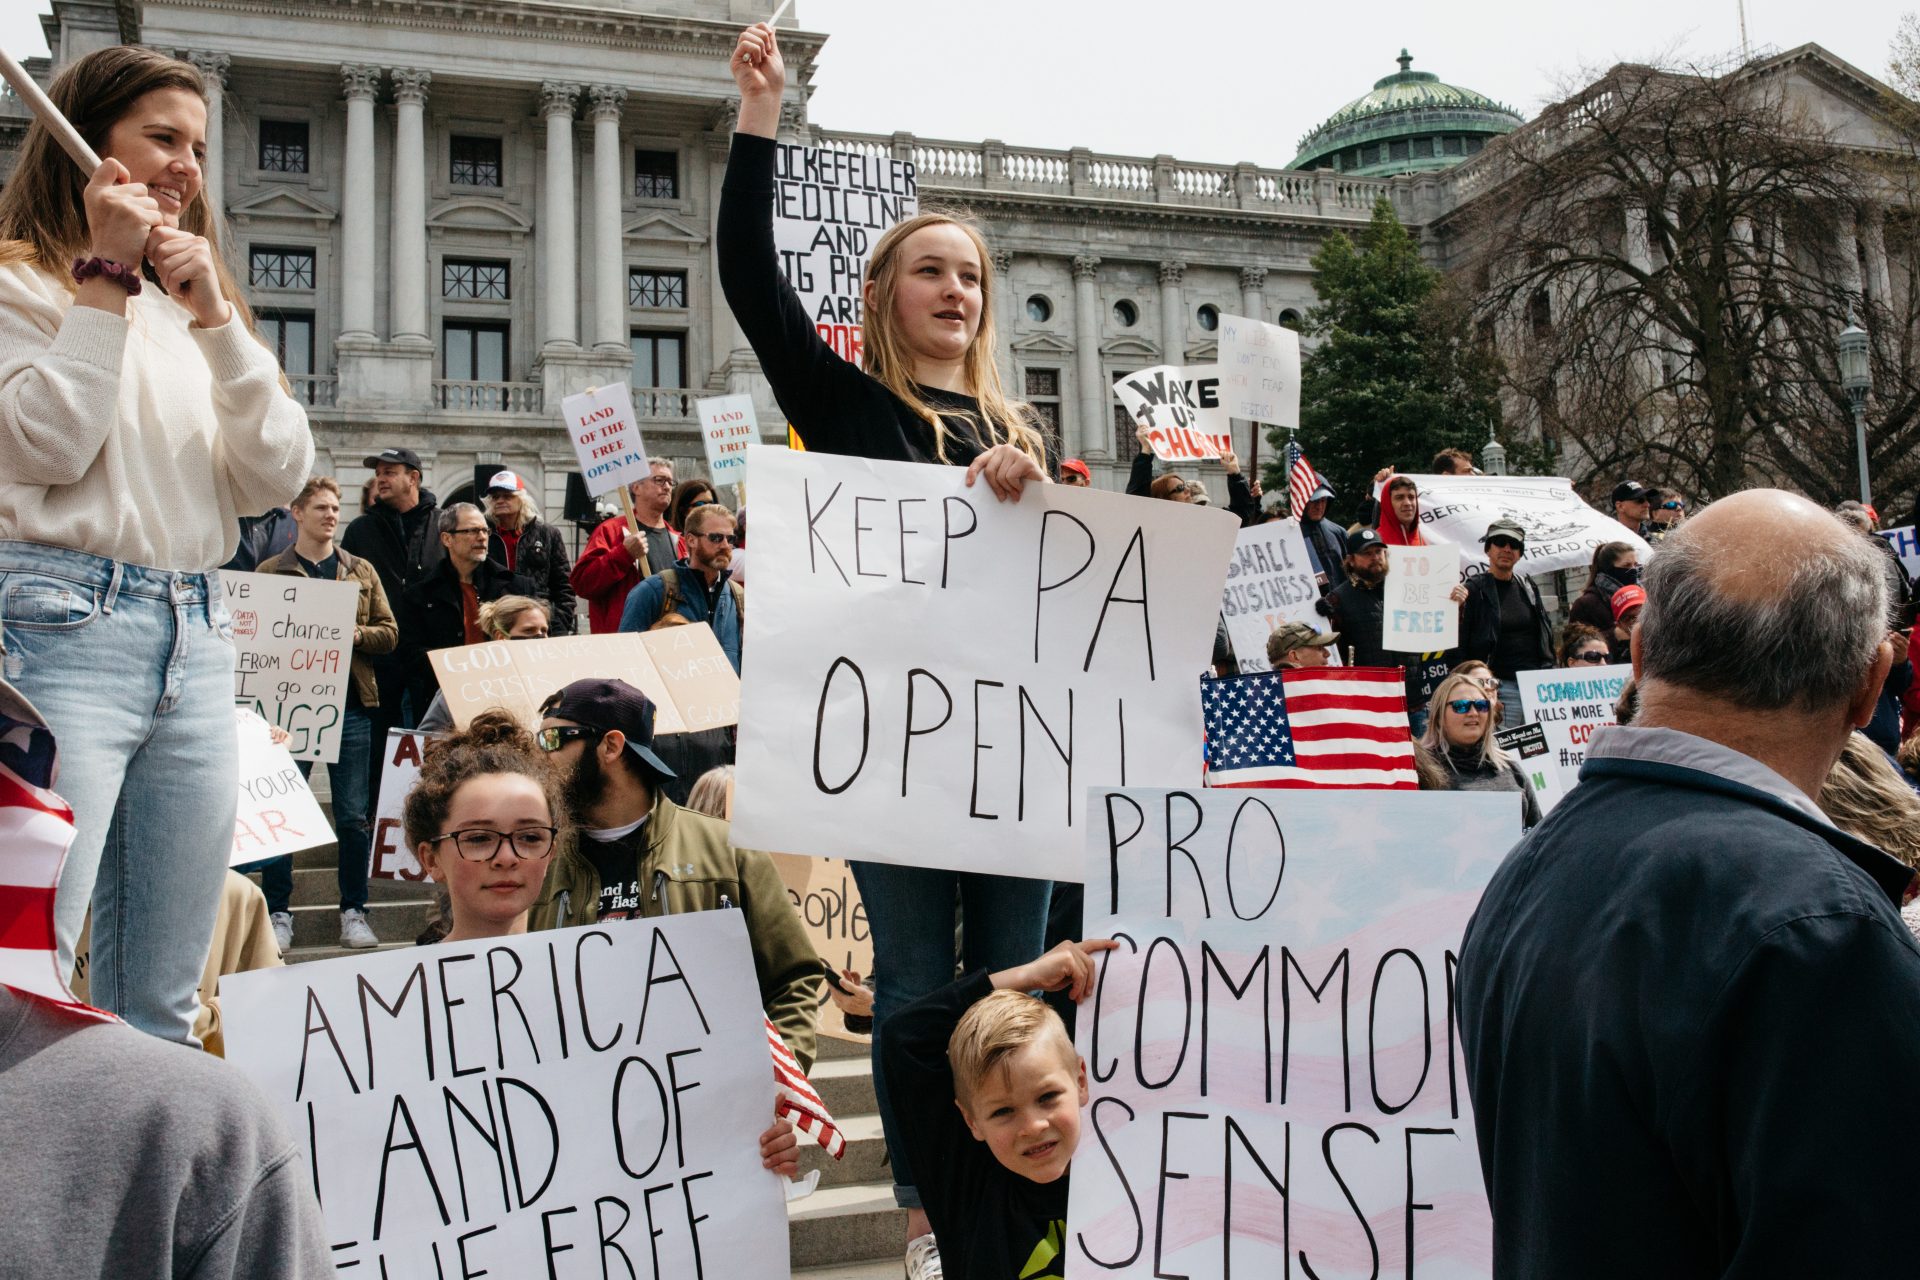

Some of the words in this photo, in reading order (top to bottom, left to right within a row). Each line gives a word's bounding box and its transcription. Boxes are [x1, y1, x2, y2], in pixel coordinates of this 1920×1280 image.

[774, 143, 917, 197] OCKEFELLER
[810, 224, 868, 257] AND
[779, 249, 815, 294] IG
[1126, 371, 1220, 410] WAKE
[579, 406, 615, 427] LAND
[712, 410, 744, 425] LAND
[1171, 405, 1197, 431] UP
[579, 430, 598, 446] OF
[599, 420, 628, 439] THE
[709, 427, 727, 440] OF
[728, 424, 753, 437] THE
[591, 438, 627, 460] FREE
[586, 459, 623, 480] OPEN
[625, 452, 642, 466] PA
[713, 456, 746, 471] OPEN
[803, 476, 979, 590] KEEP
[1034, 510, 1156, 683] PA
[1402, 556, 1431, 577] TO
[283, 586, 298, 604] a
[1221, 573, 1315, 617] BUSINESS
[1402, 583, 1431, 605] BE
[271, 613, 343, 642] chance
[1391, 608, 1445, 634] FREE
[239, 651, 281, 671] FROM
[289, 648, 341, 675] CV-19
[442, 643, 513, 674] GOD
[525, 640, 595, 664] NEVER
[672, 629, 695, 652] A
[661, 654, 730, 682] WASTE
[233, 670, 259, 699] I
[274, 680, 301, 702] go
[310, 681, 337, 697] on
[1533, 705, 1568, 722] KILLS
[1571, 703, 1605, 720] MORE
[239, 768, 305, 803] YOUR
[1104, 792, 1287, 922] PRO
[611, 895, 639, 909] flag
[295, 925, 712, 1103] AMERICA
[611, 1047, 704, 1180] OF
